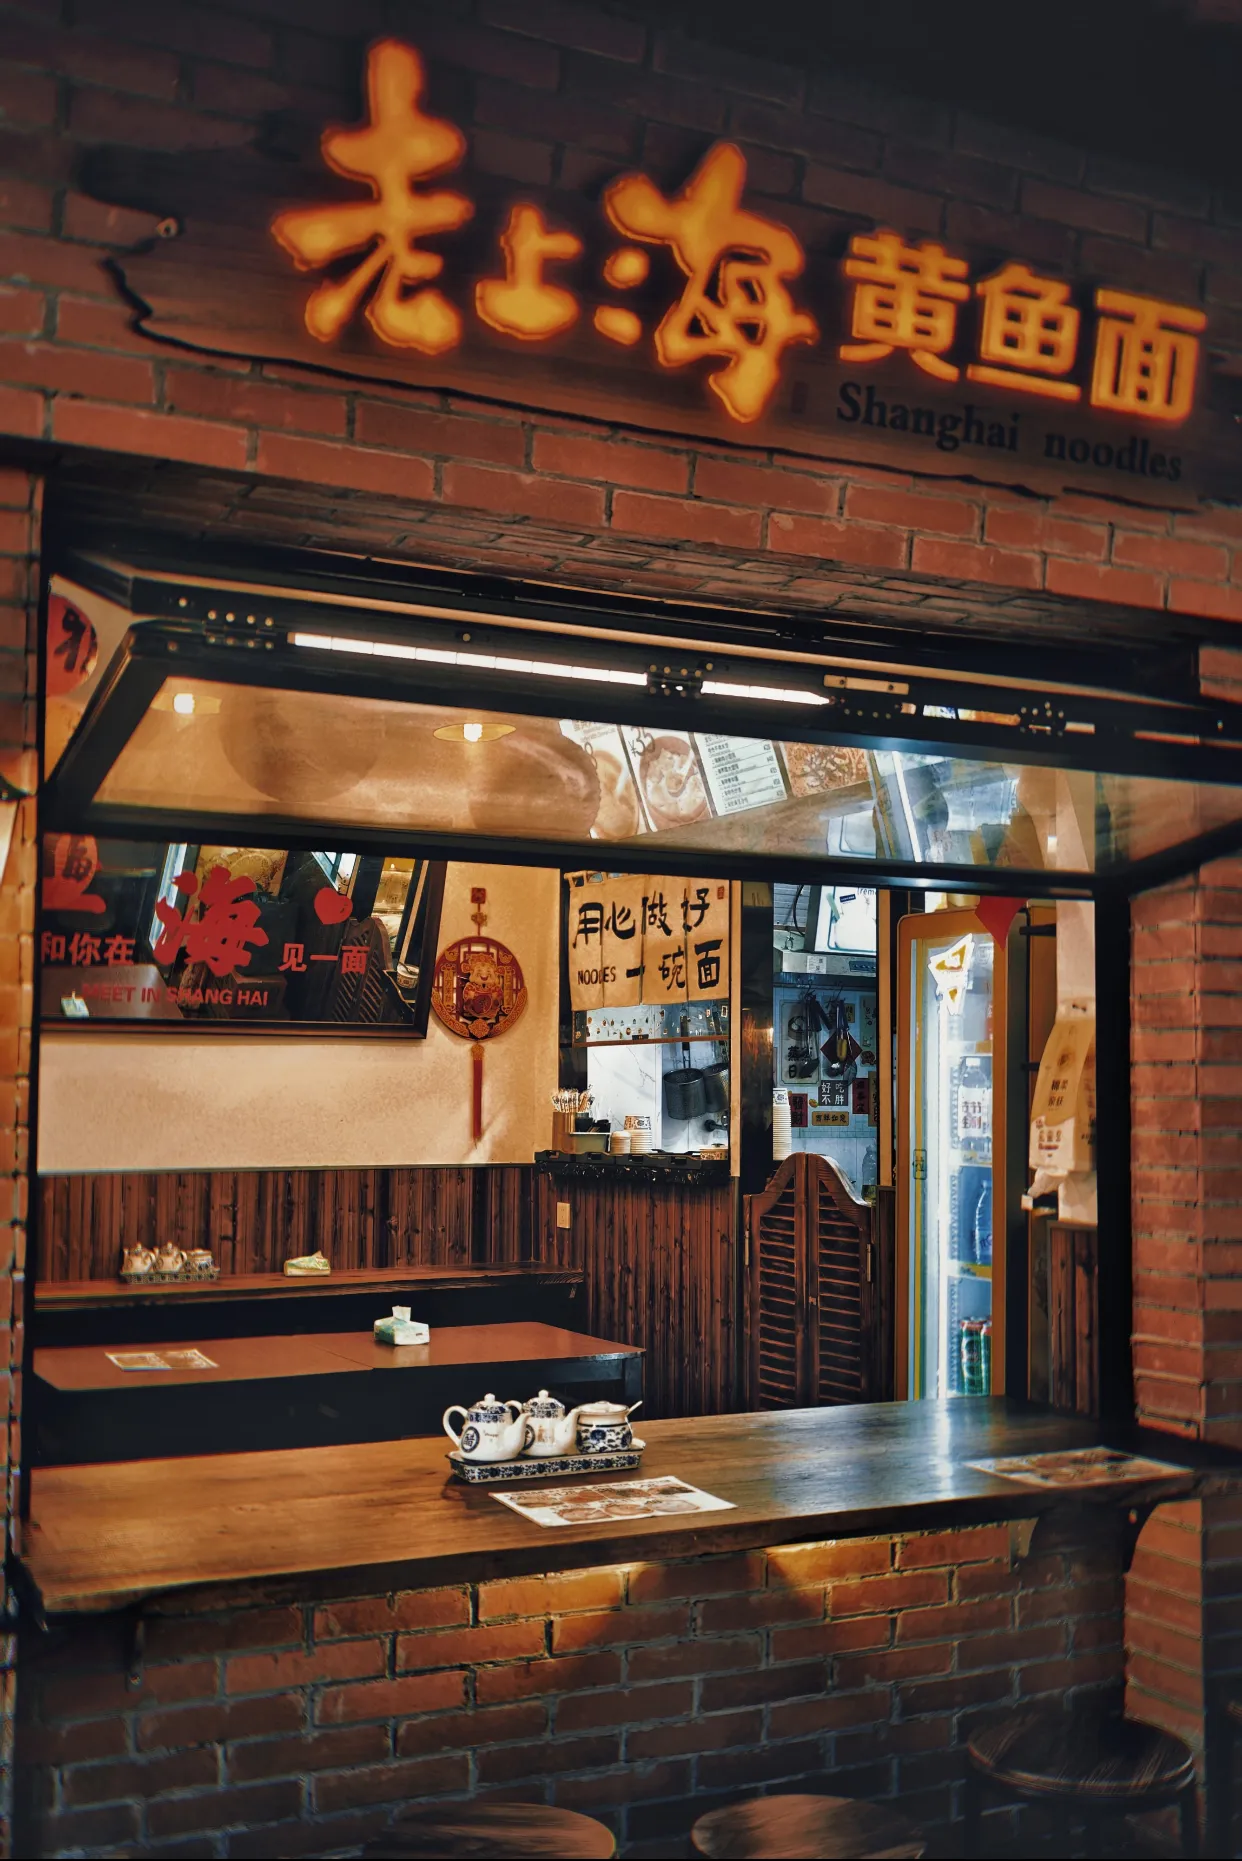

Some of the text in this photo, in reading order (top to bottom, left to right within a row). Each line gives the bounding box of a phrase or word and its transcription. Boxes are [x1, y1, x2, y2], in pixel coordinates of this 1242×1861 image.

[271, 37, 1207, 423] 老上海 黄鱼面
[836, 381, 1183, 482] Shanghai noodles
[572, 888, 710, 949] 用心做好
[278, 942, 370, 974] 见一面
[626, 939, 723, 991] 一碗面
[577, 965, 616, 985] NOOES
[82, 984, 268, 1007] MEET IN SHANG HAI
[821, 1082, 845, 1094] 好吃
[821, 1094, 845, 1106] 不胖
